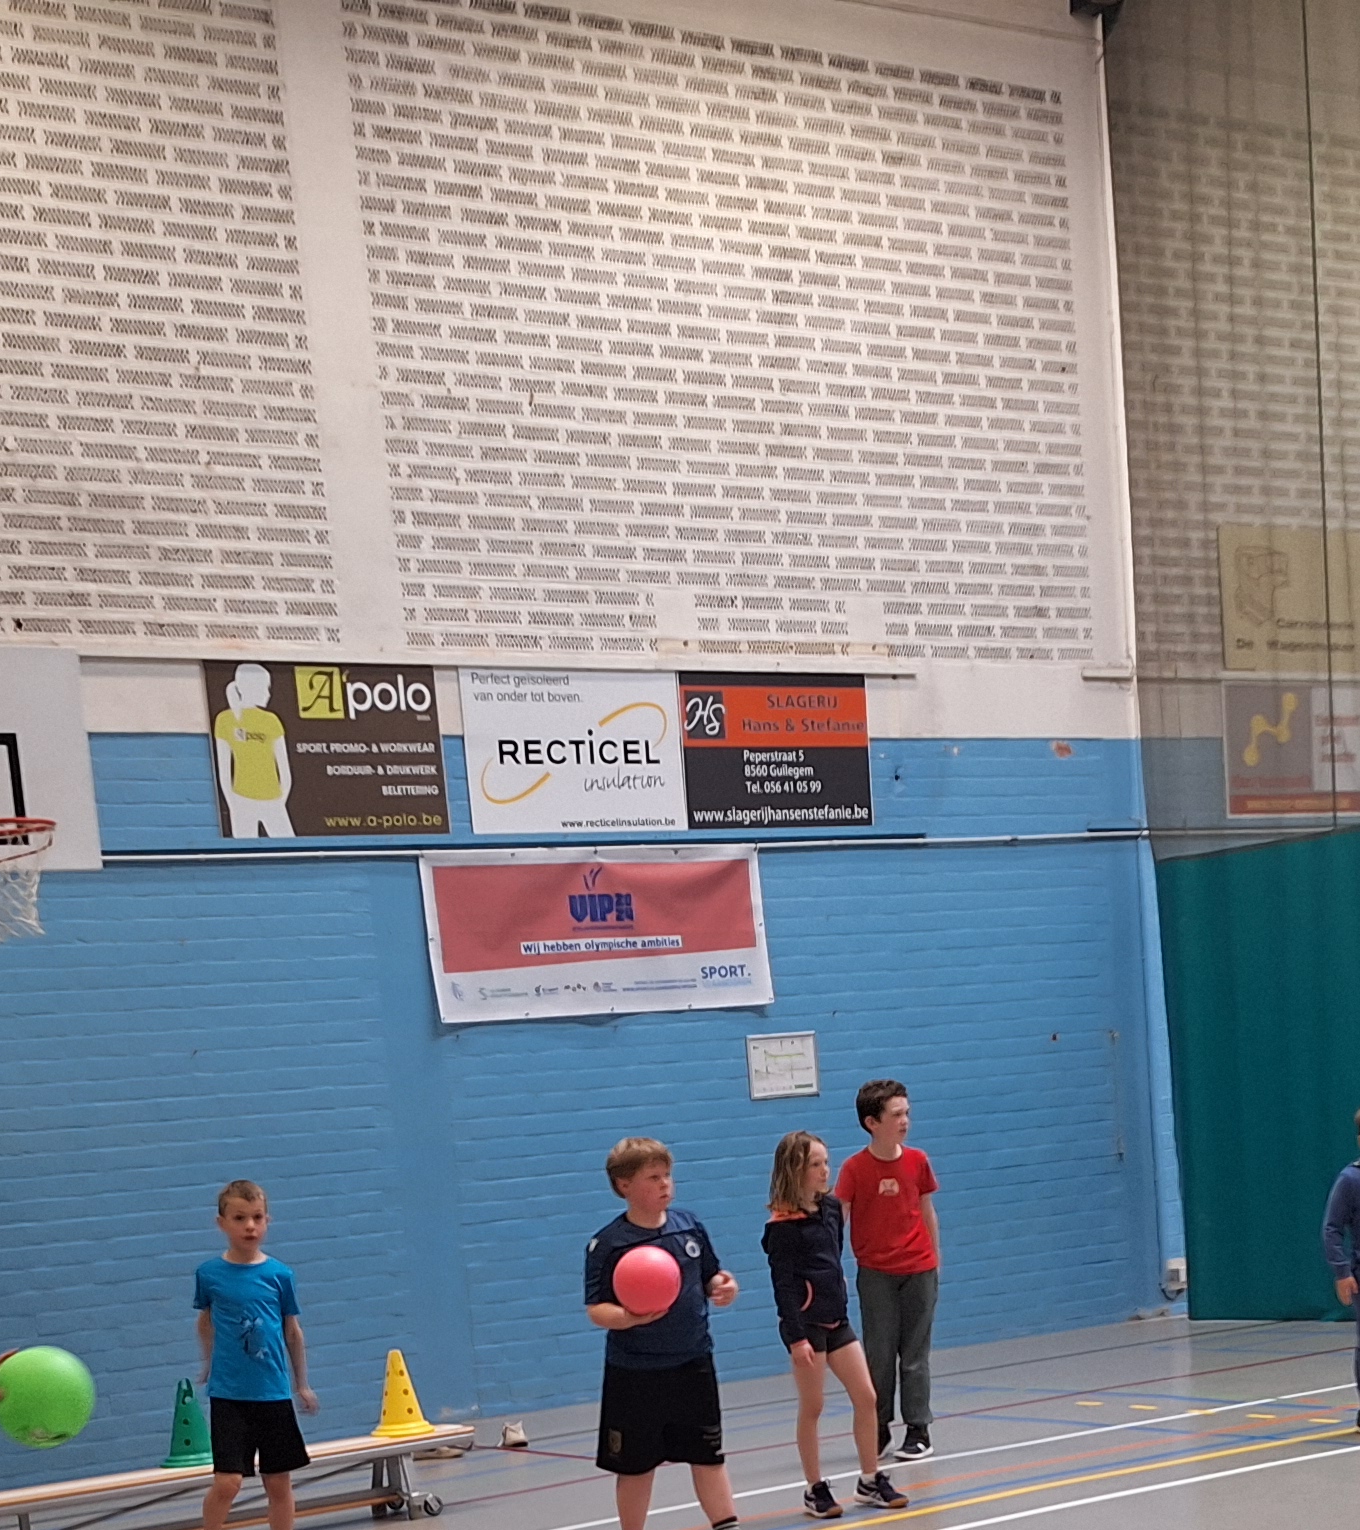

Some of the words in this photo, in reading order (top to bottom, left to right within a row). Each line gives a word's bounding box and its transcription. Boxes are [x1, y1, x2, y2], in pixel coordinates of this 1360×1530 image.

[471, 672, 511, 685] Perfect
[473, 692, 494, 702] van
[496, 690, 528, 702] onder
[530, 691, 545, 702] tot
[767, 694, 838, 709] SLAGERIJ
[742, 718, 780, 732] Hans
[785, 719, 796, 732] &
[801, 718, 865, 733] Stefanie
[380, 743, 435, 754] WORKWEAR
[743, 749, 797, 764] Peperstraat
[798, 750, 805, 762] 5
[386, 765, 438, 776] DRUKWERK
[744, 764, 768, 777] 8560
[769, 764, 814, 780] Gullegem
[584, 766, 665, 792] insulation
[745, 781, 763, 794] Tel.
[764, 781, 781, 793] 056
[783, 781, 794, 793] 41
[796, 781, 808, 793] 05
[809, 781, 822, 793] 99
[325, 812, 443, 828] www.a-polo.be
[693, 804, 869, 825] www.slagerijhansenstefanie.be
[561, 817, 676, 829] www.recticelinsulation.be
[522, 943, 541, 955] Wij
[543, 941, 581, 952] hebben
[584, 938, 638, 952] olympische
[640, 936, 680, 949] ambities
